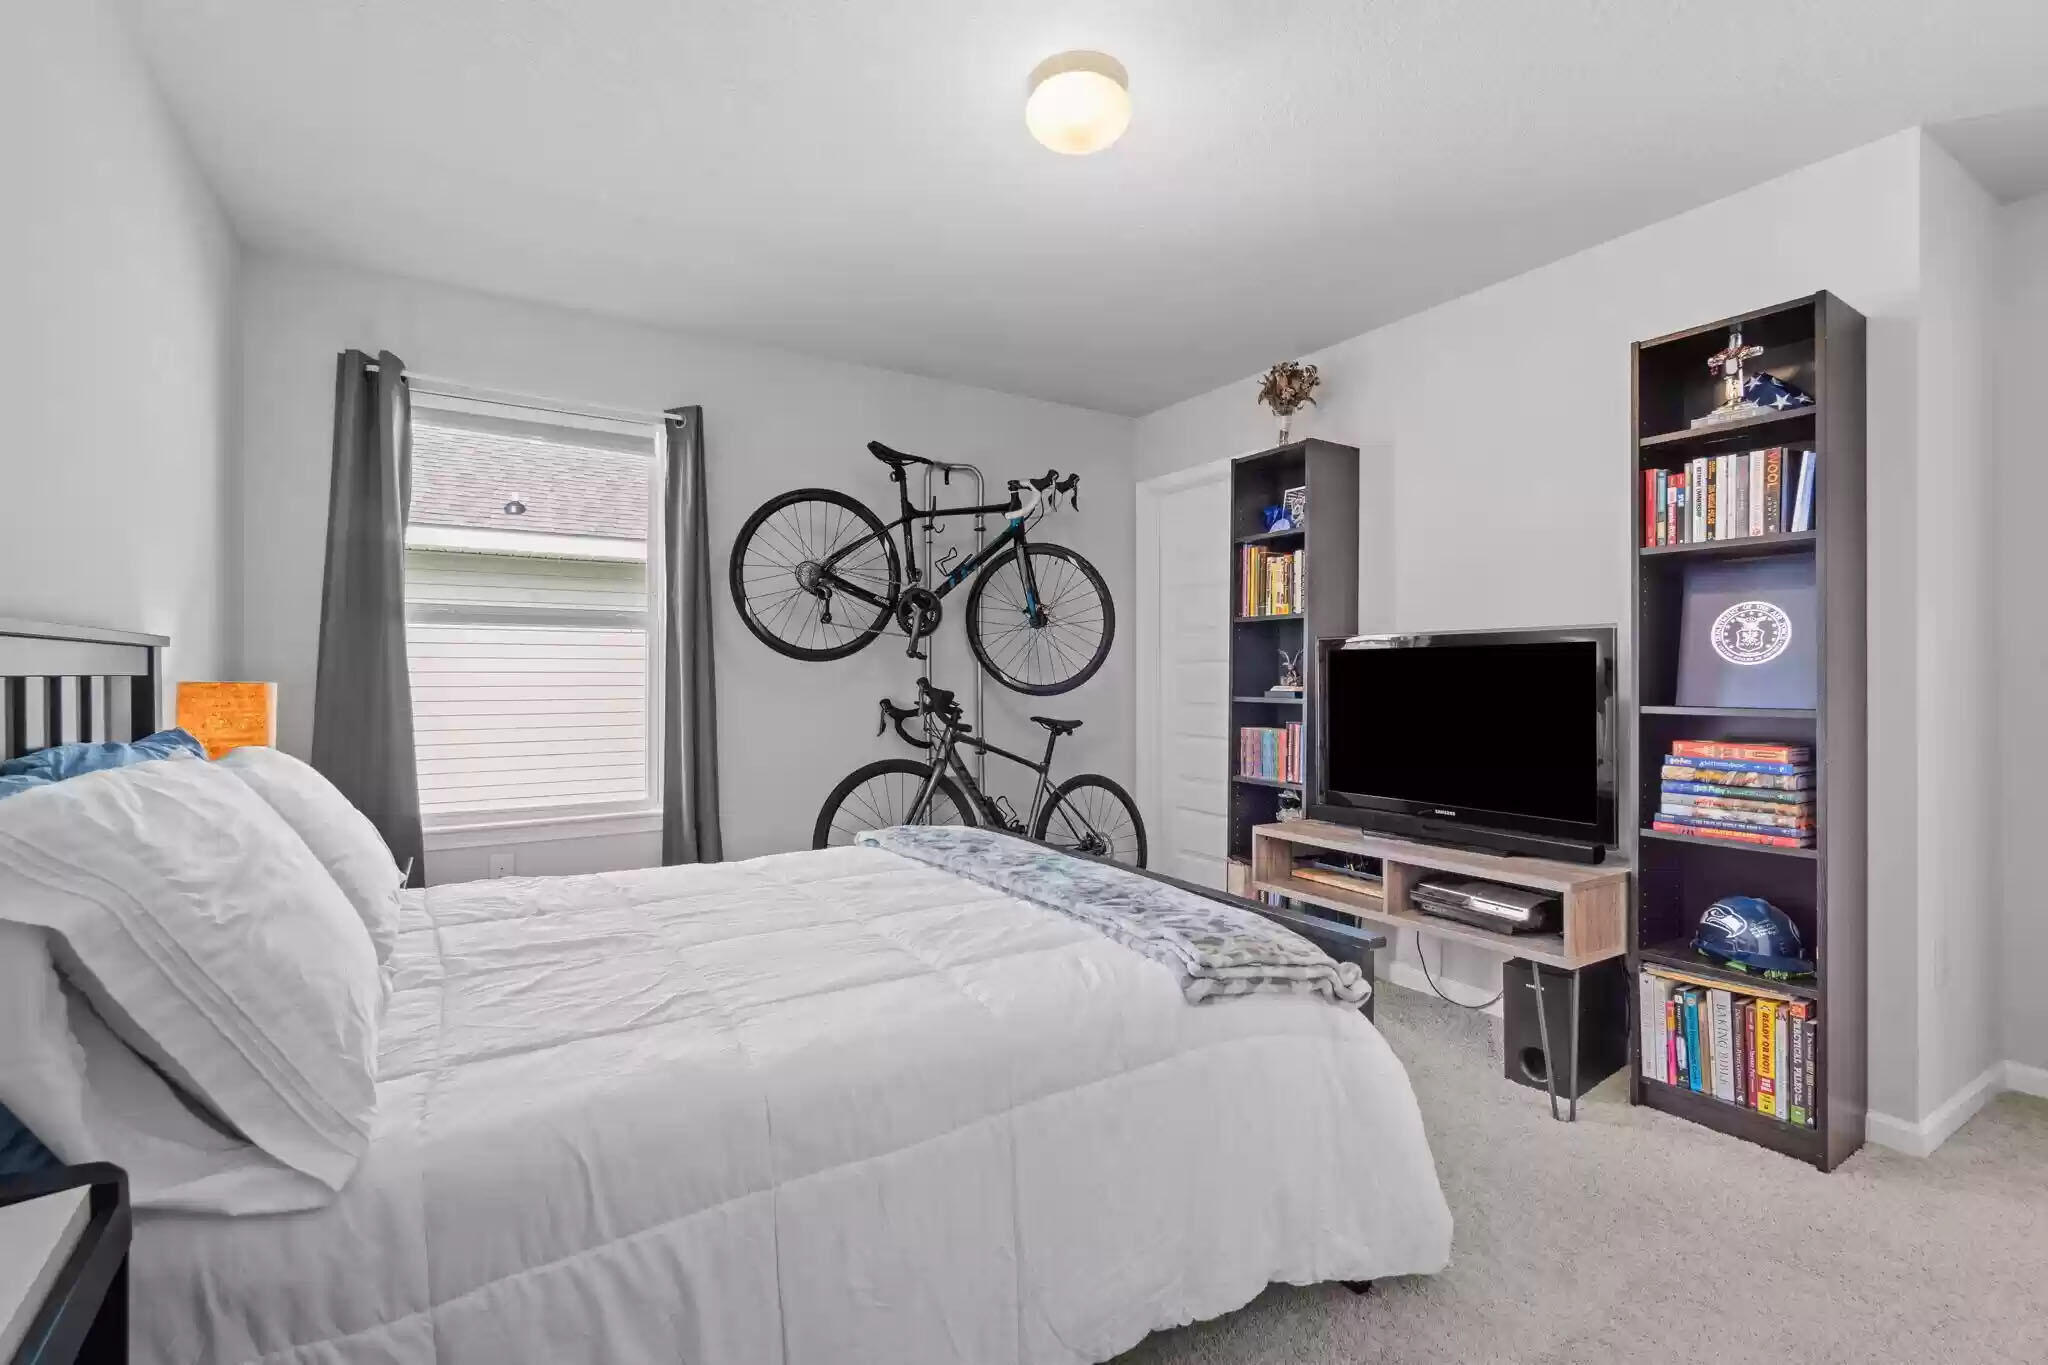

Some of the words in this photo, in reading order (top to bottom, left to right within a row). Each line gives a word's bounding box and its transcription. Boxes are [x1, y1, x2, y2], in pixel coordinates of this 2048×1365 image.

[1767, 451, 1779, 489] WOOL
[1716, 1004, 1728, 1049] BAKING
[1792, 1018, 1803, 1063] PRACTICAL
